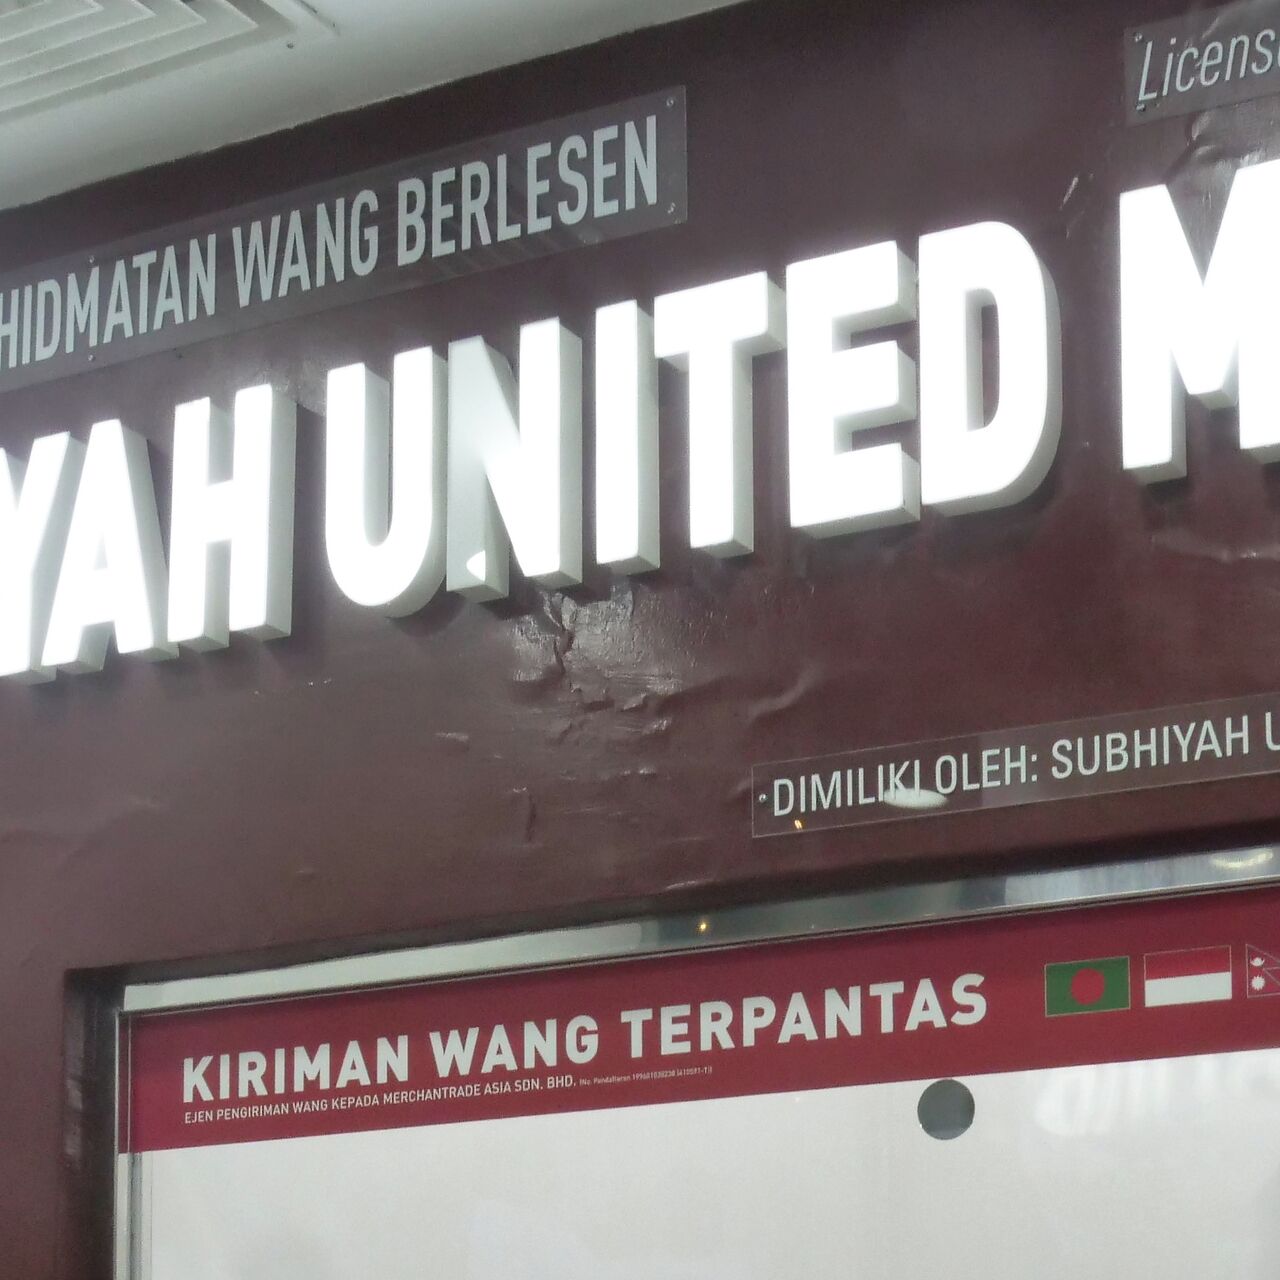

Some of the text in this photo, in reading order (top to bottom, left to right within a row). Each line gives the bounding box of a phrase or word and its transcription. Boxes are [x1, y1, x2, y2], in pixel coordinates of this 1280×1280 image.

[234, 187, 379, 308] WANG
[398, 114, 659, 267] BERLESEN
[325, 222, 1057, 612] UNITED
[773, 756, 923, 817] DIMILIKI
[935, 745, 1039, 796] OLEH:
[1051, 714, 1251, 780] SUBHIYAH
[183, 972, 988, 1104] KIRIMAN WANG TERPANTAS
[185, 1075, 576, 1124] EJEN PENGIRIMAN WANG KEPADA MERCHANTRADE ASIA SDN. BHD.
